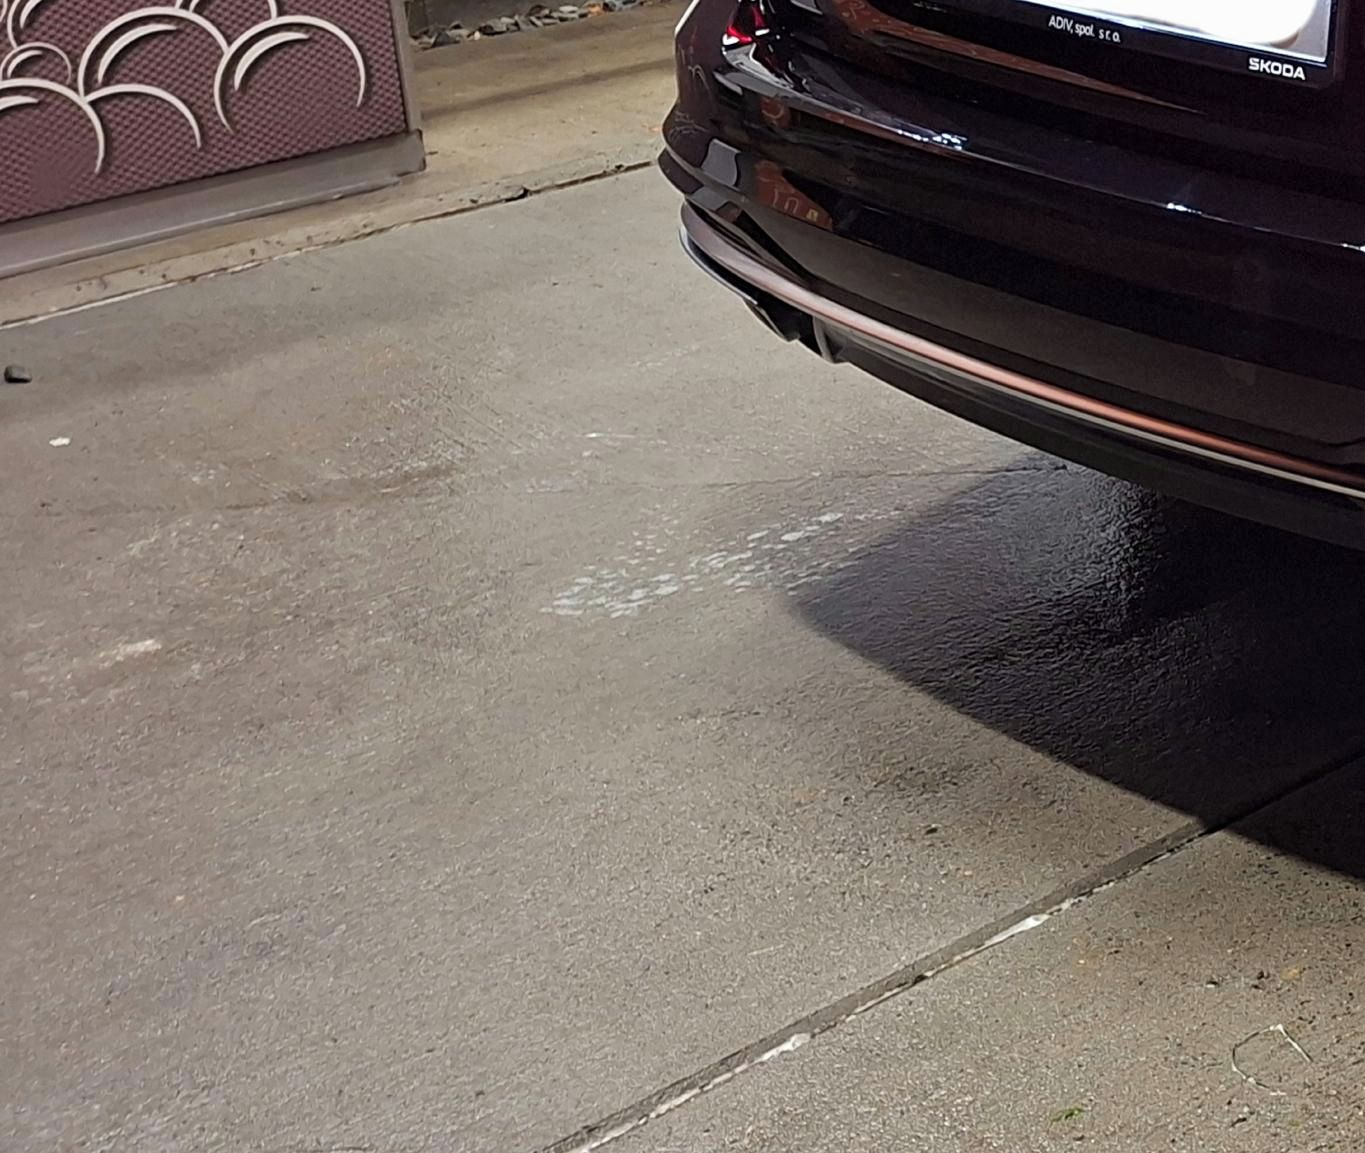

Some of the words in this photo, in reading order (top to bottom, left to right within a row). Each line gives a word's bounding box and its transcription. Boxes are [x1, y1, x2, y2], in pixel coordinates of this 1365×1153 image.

[1048, 15, 1073, 34] ADIV,
[1075, 23, 1095, 38] spol.
[1248, 57, 1306, 81] SKODA
